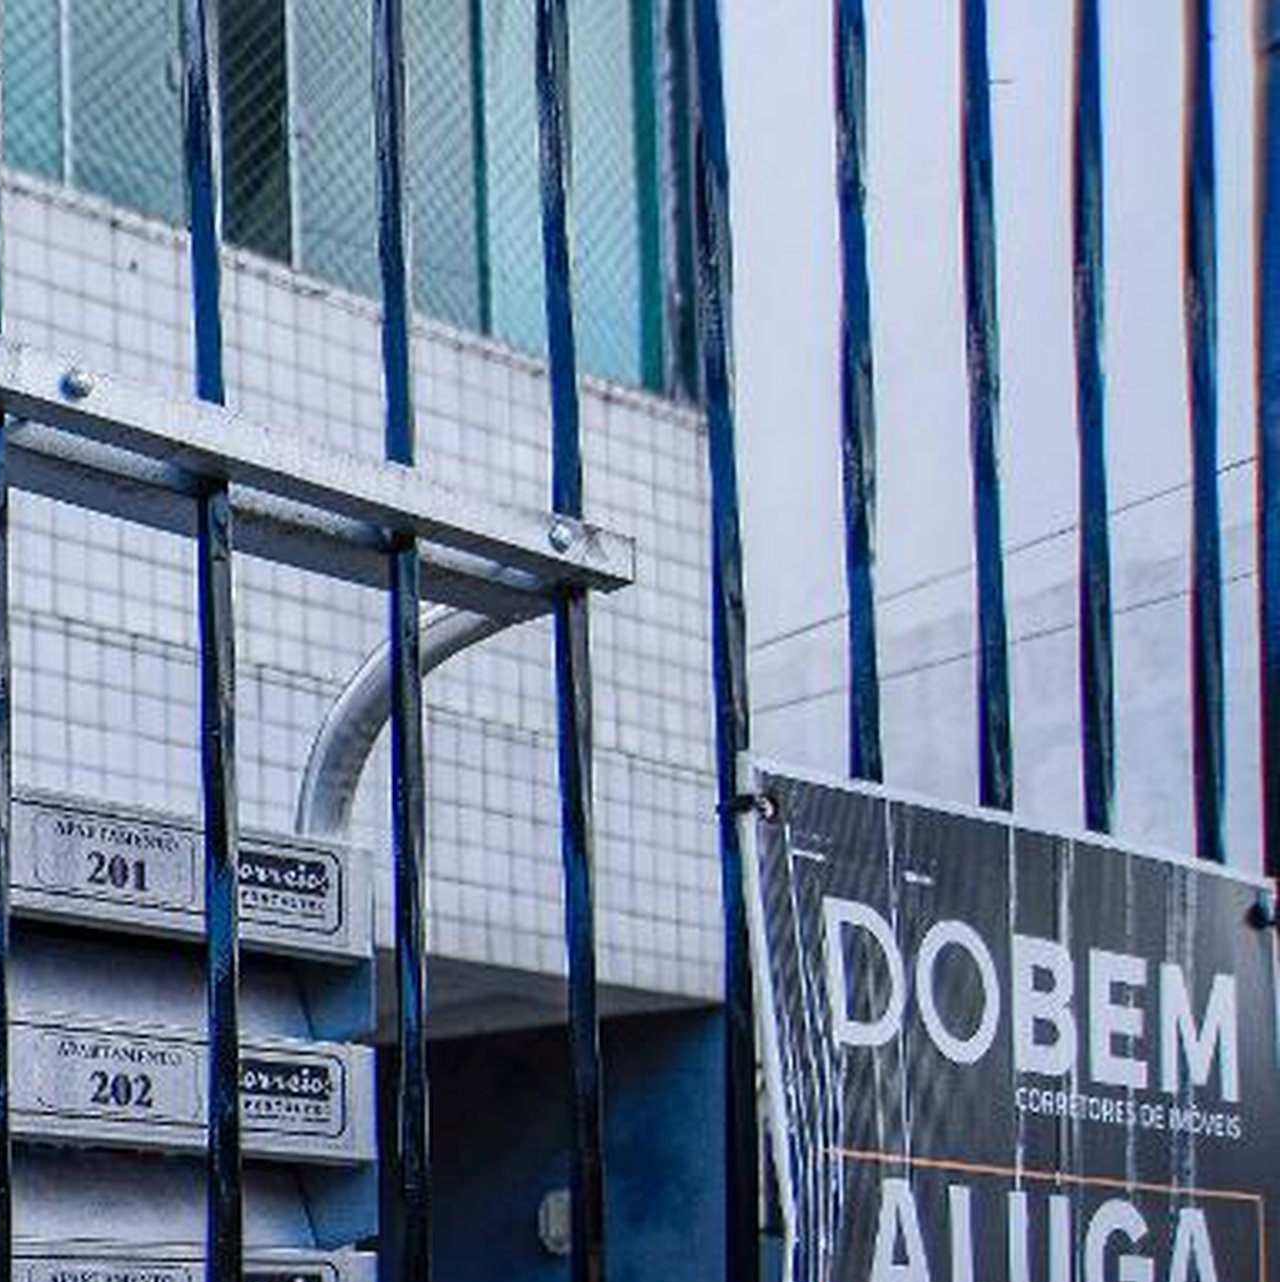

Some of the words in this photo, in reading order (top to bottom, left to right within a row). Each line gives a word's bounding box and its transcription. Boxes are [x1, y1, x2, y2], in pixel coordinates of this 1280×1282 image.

[87, 851, 149, 892] 201
[822, 896, 1240, 1101] DOBEM
[90, 1070, 152, 1108] 202
[1015, 1087, 1136, 1124] CORRETORES
[1142, 1104, 1165, 1129] DE
